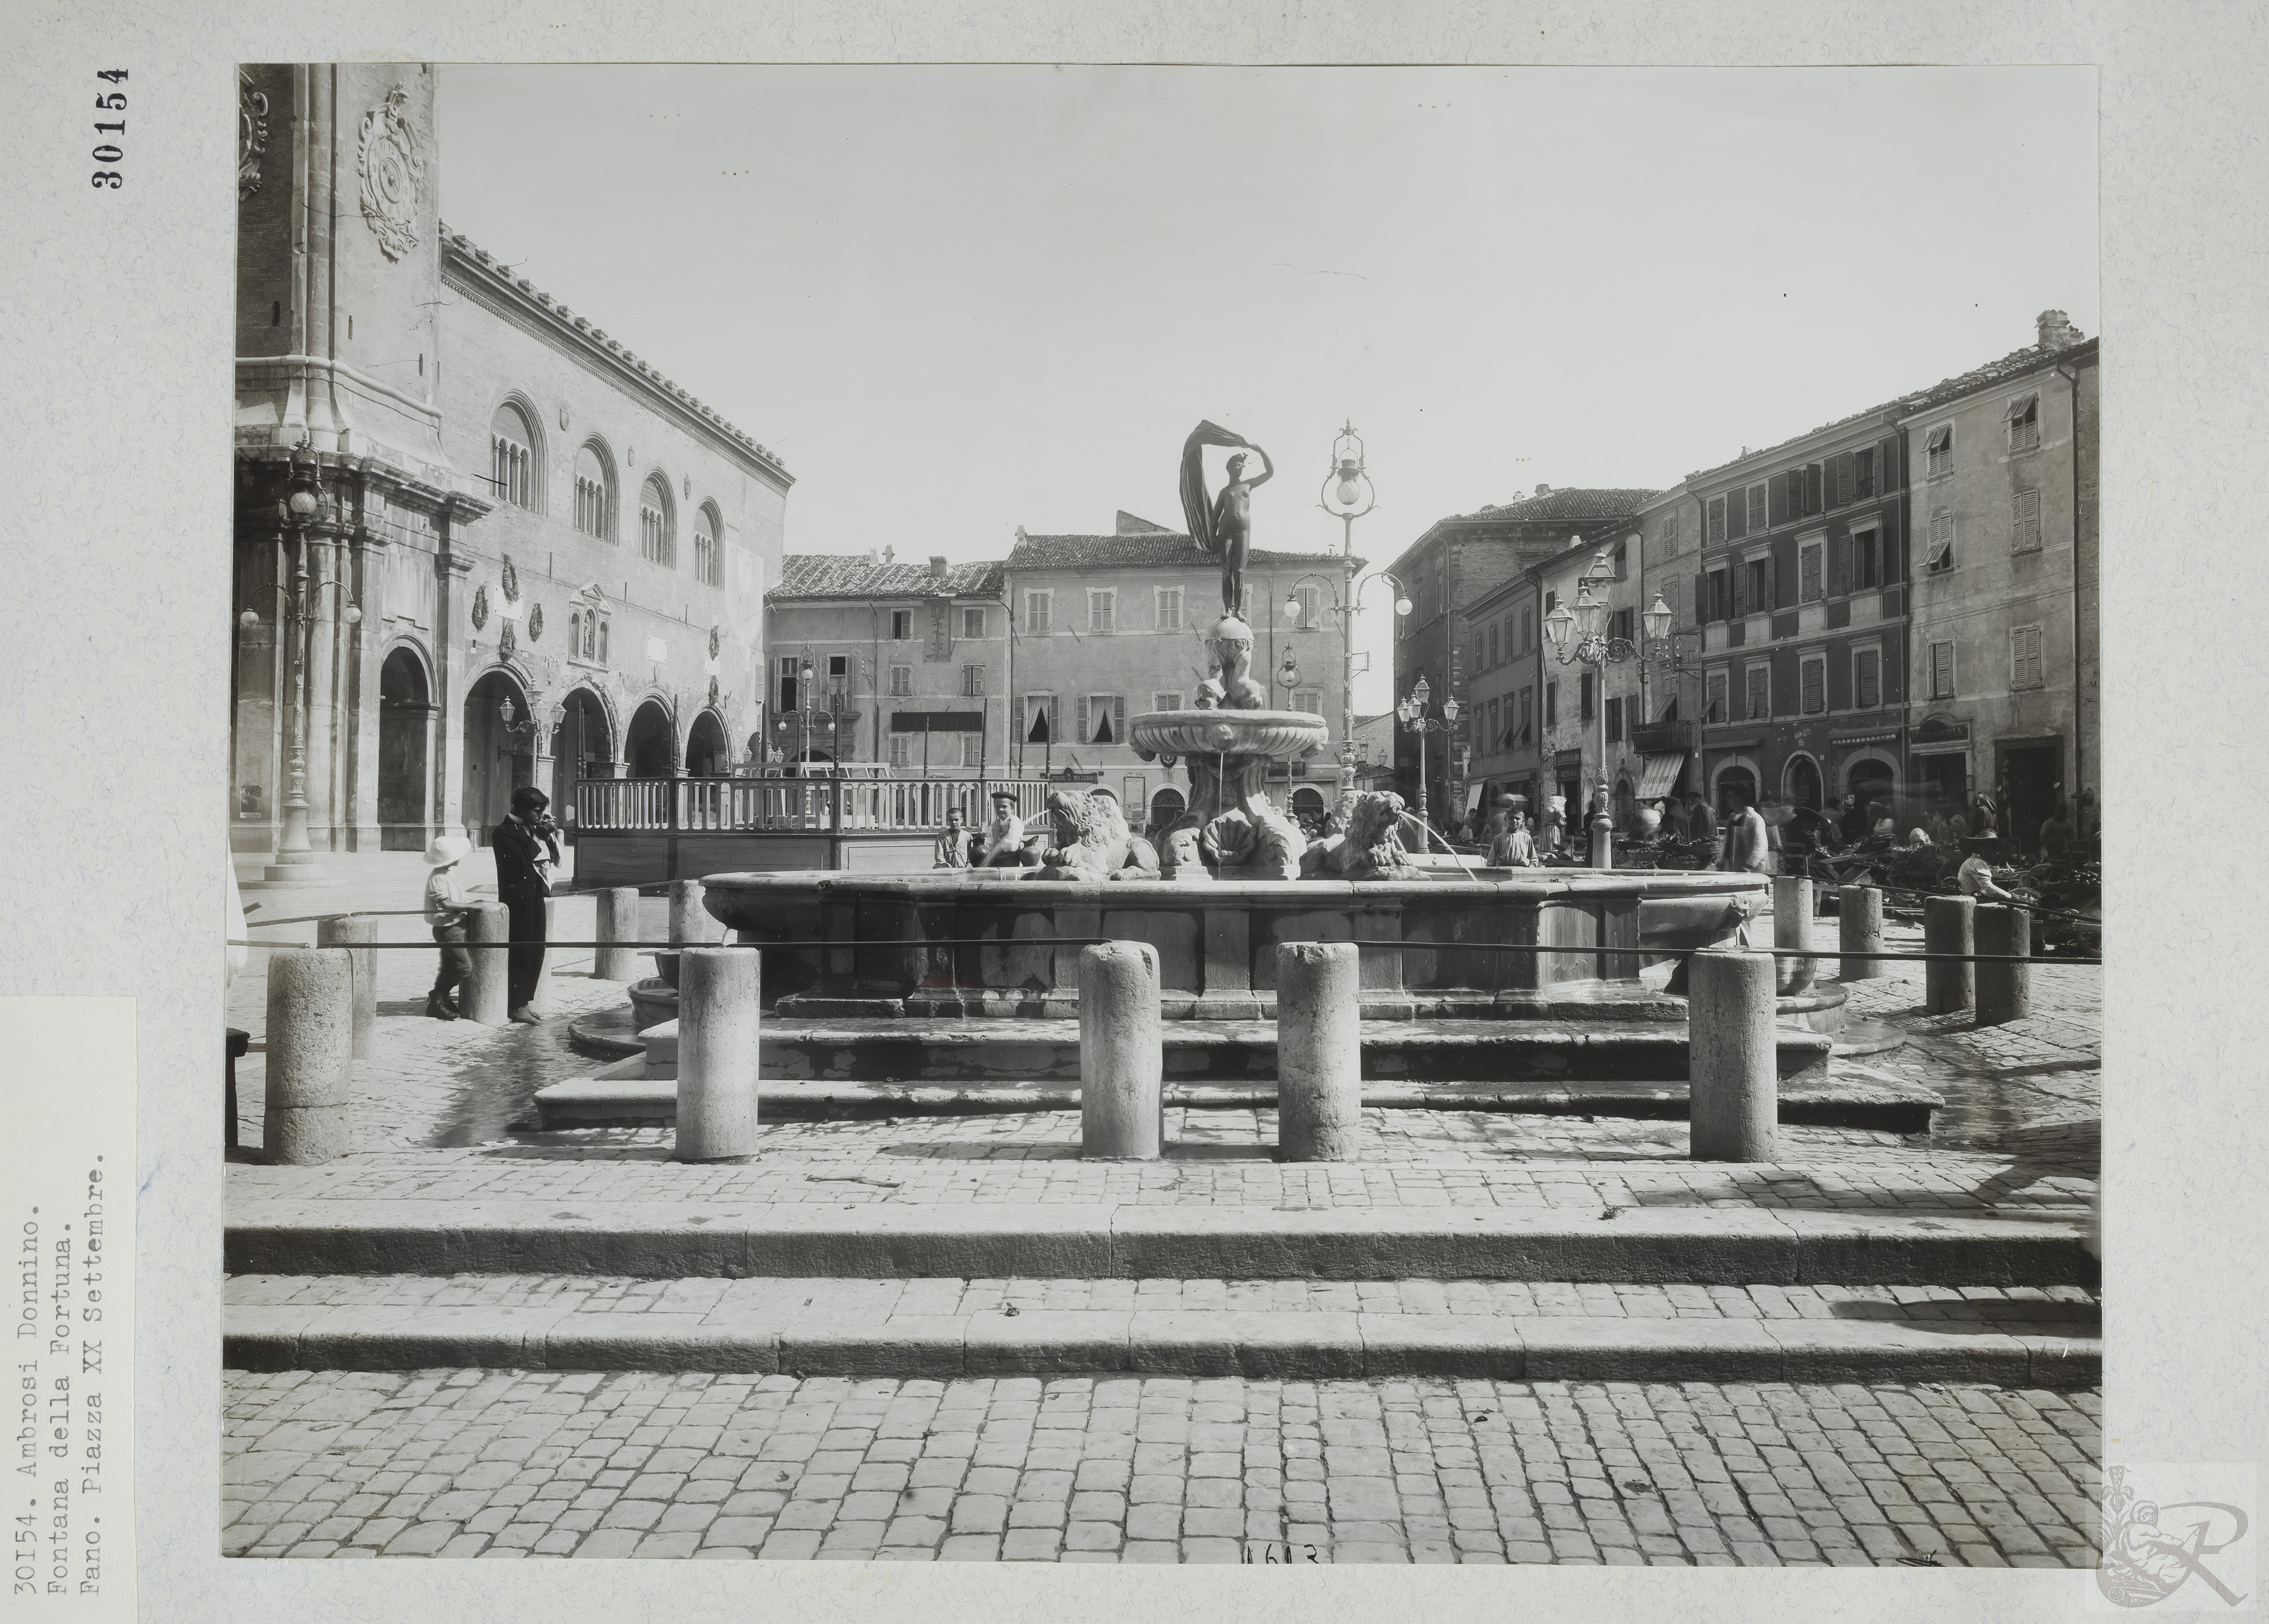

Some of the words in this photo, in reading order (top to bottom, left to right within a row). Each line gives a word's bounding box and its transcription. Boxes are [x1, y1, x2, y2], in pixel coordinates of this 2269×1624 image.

[92, 69, 128, 189] 30154
[16, 1207, 39, 1339] Donnino.
[49, 1224, 71, 1356] Fortuna.
[82, 1155, 104, 1322] Settembre.
[82, 1341, 102, 1374] XX
[16, 1360, 37, 1478] Ambrosi
[48, 1376, 69, 1459] della
[81, 1392, 102, 1494] Piazza
[47, 1478, 69, 1596] Fontana
[80, 1517, 101, 1596] Fano.
